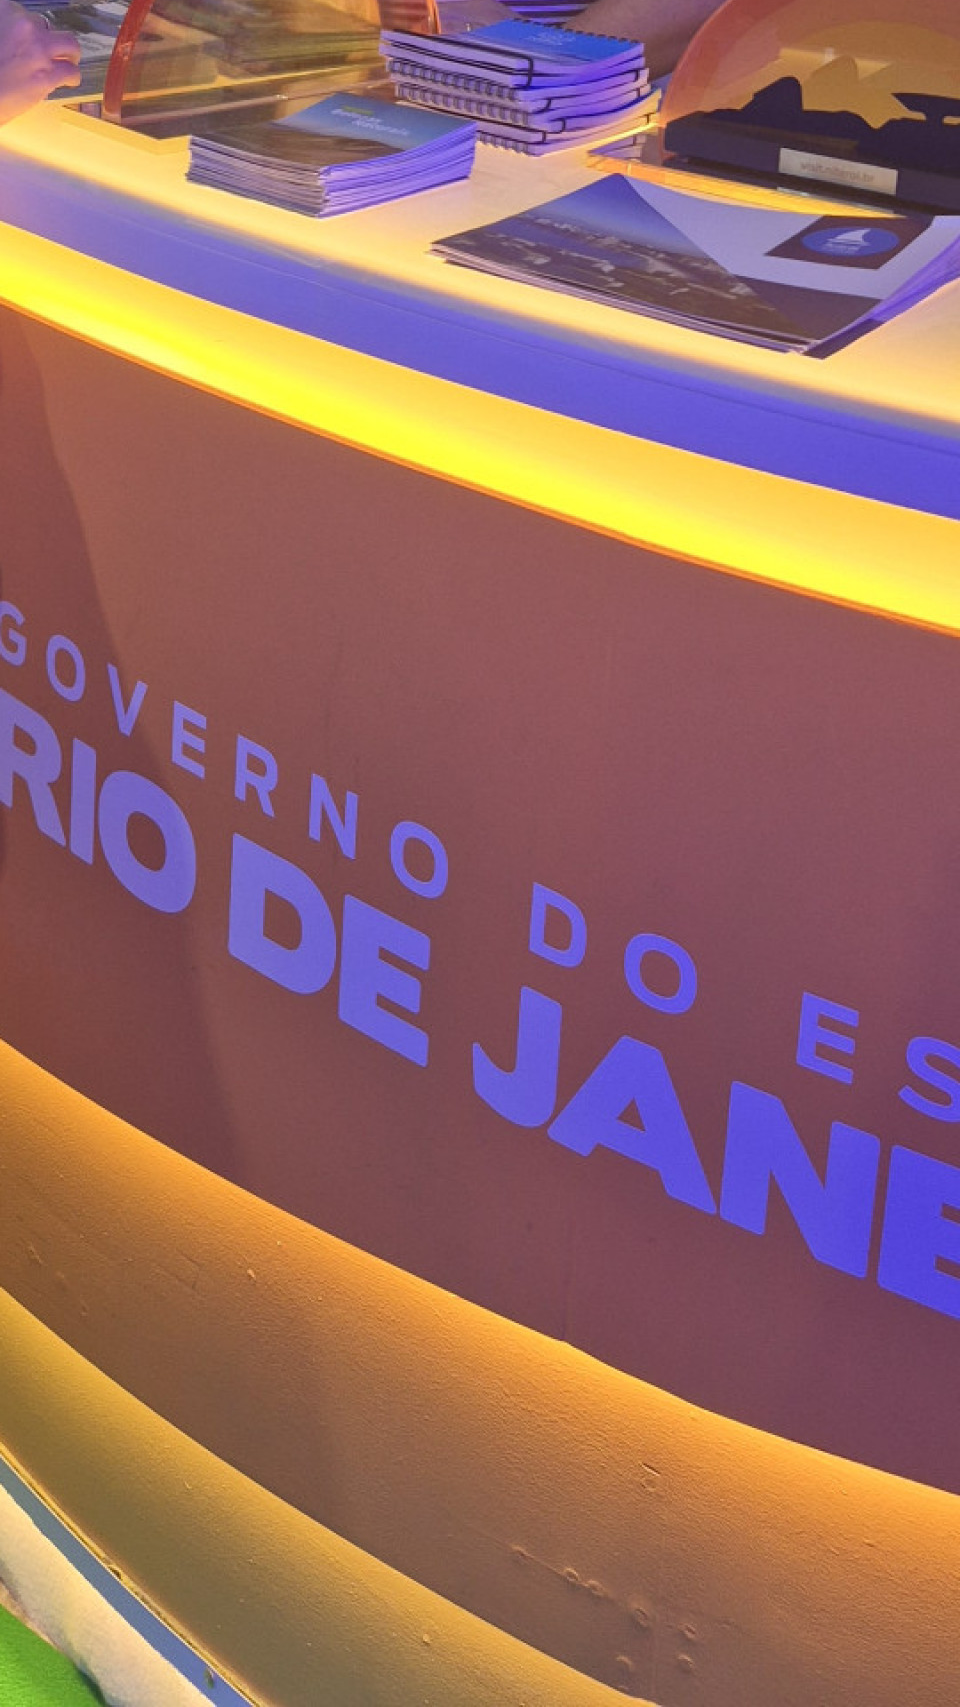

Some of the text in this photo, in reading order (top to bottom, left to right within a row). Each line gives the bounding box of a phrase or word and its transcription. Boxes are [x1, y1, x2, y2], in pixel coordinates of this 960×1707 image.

[228, 832, 432, 1069] DE
[472, 985, 960, 1322] JANE
[529, 881, 699, 1016] DO
[796, 991, 960, 1124] ES
